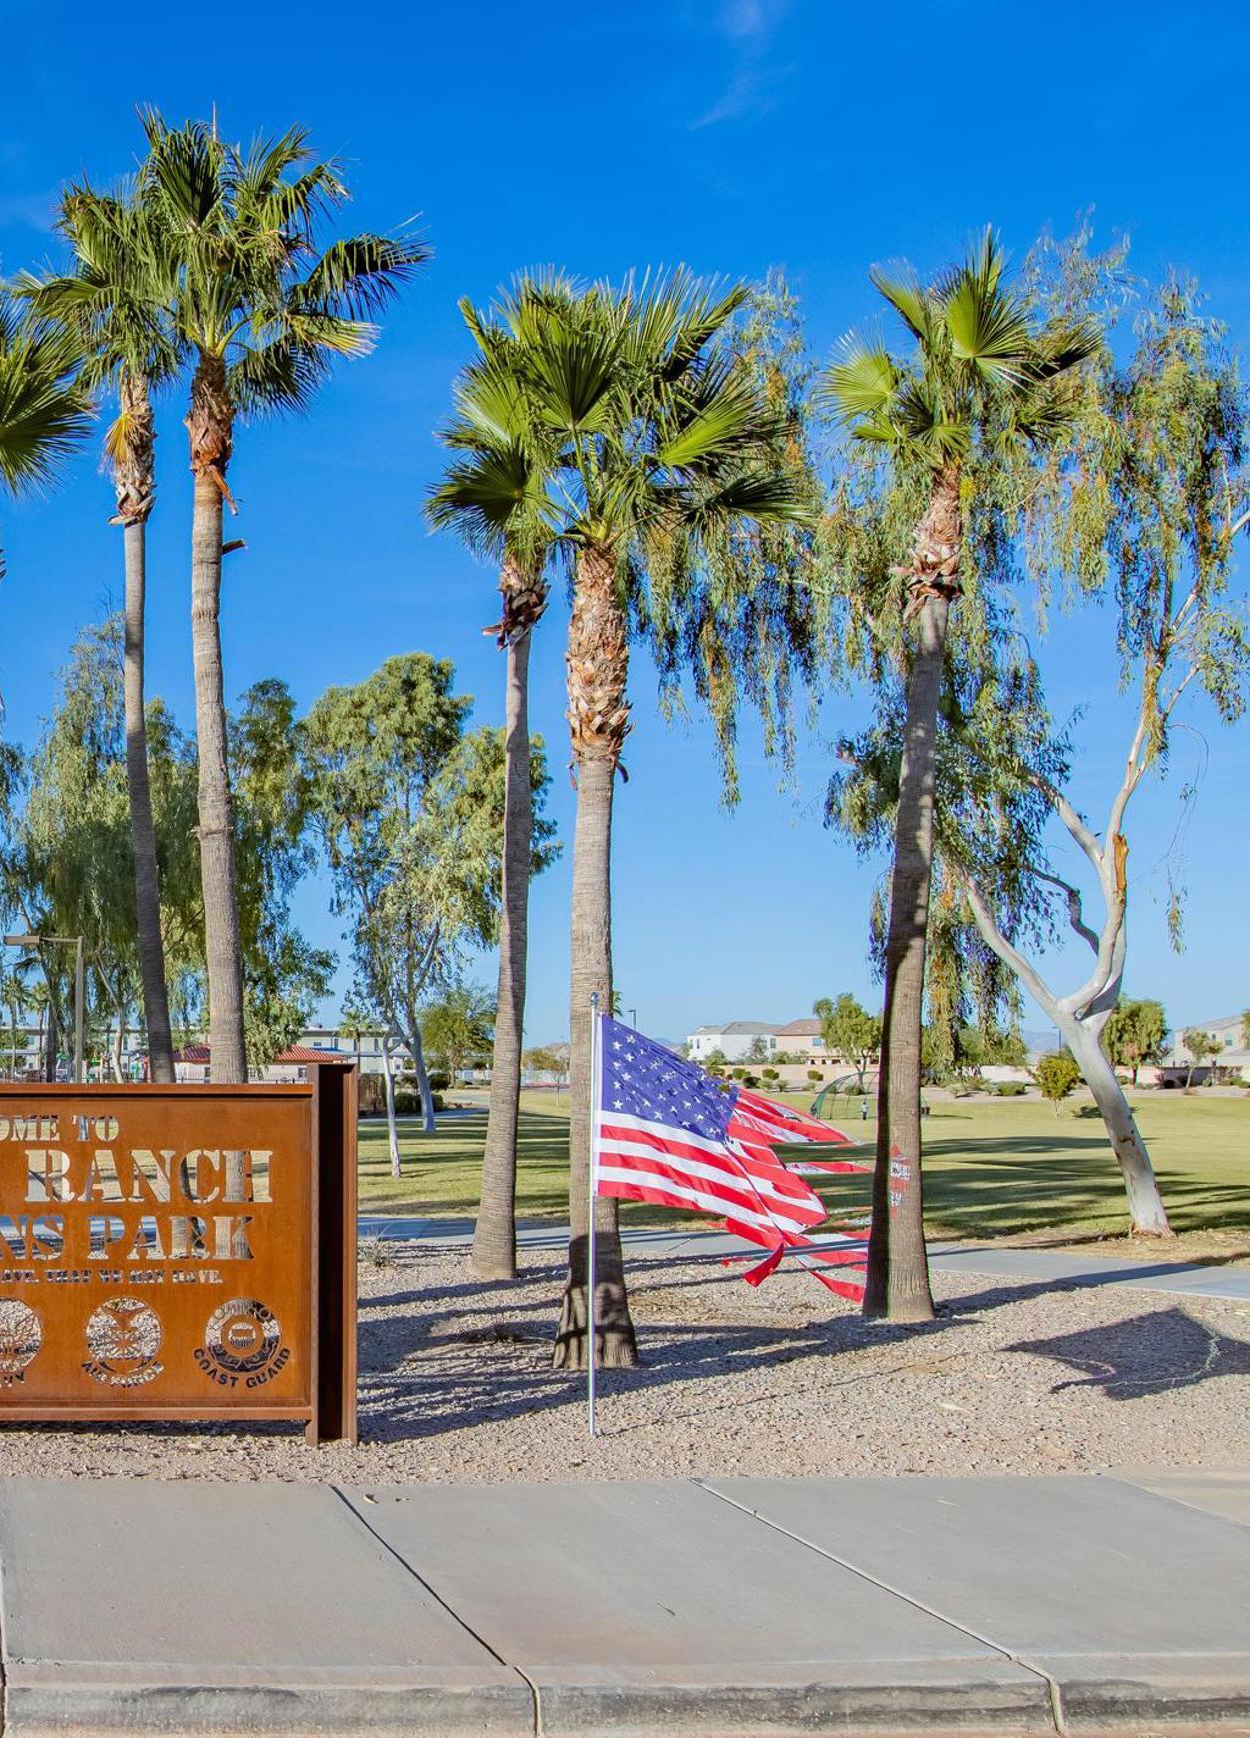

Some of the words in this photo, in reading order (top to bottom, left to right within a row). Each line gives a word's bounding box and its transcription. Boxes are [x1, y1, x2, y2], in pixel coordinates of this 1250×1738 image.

[72, 1115, 120, 1142] TO
[25, 1149, 274, 1204] RANCH
[86, 1215, 255, 1260] PARK
[45, 1269, 92, 1284] THAT
[99, 1269, 123, 1284] WE
[81, 1361, 108, 1384] AIR
[110, 1361, 165, 1389] FORCE
[193, 1348, 239, 1387] COAST
[246, 1348, 291, 1388] GUARD
